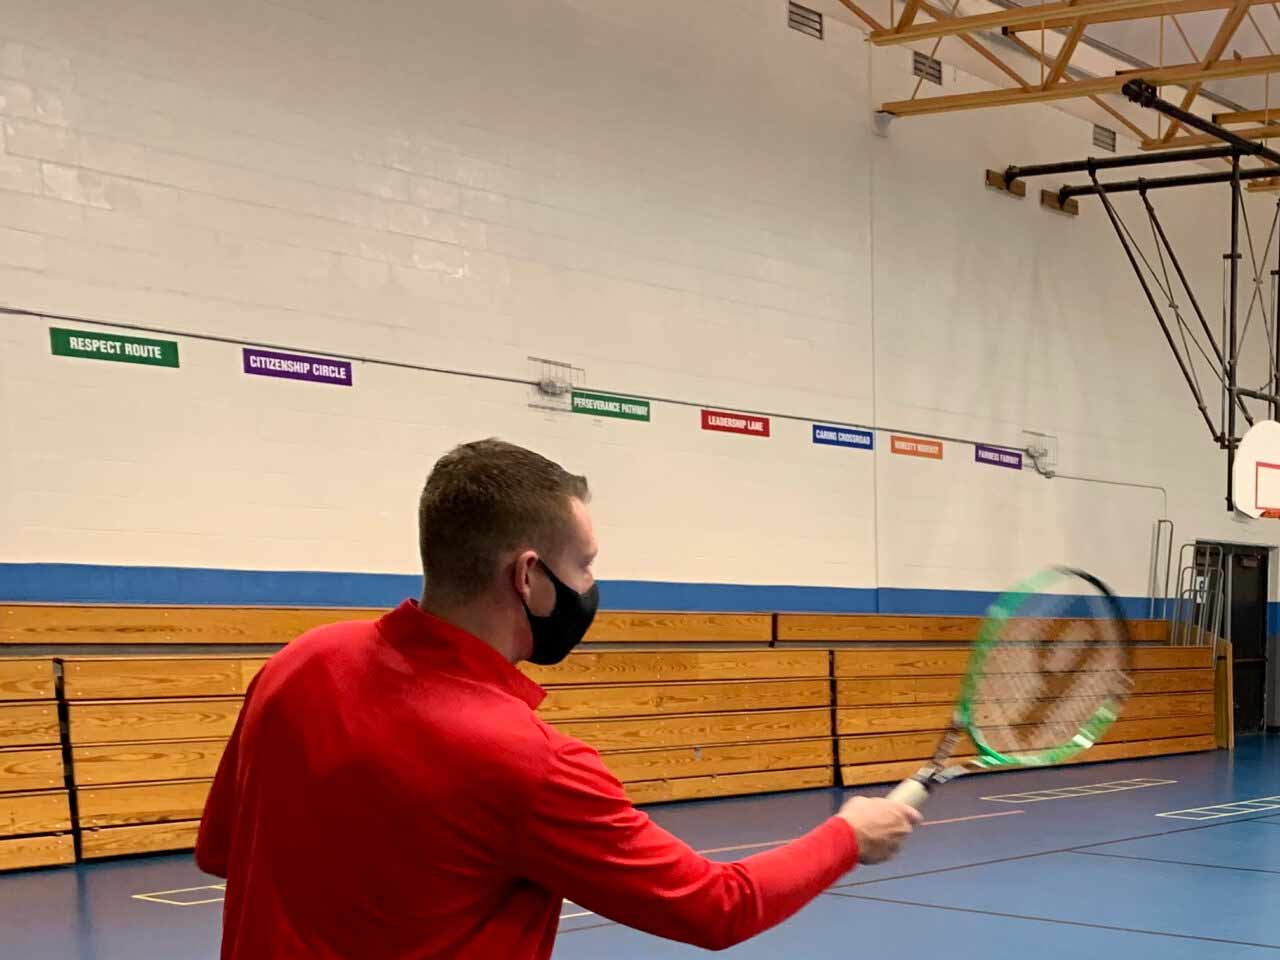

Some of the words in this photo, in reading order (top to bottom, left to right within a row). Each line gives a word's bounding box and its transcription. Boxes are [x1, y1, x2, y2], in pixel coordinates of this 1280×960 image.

[69, 336, 122, 354] RESPECT
[125, 343, 162, 359] ROUTE
[249, 355, 310, 374] CITIZENSHIP
[312, 363, 347, 379] CIRCLE
